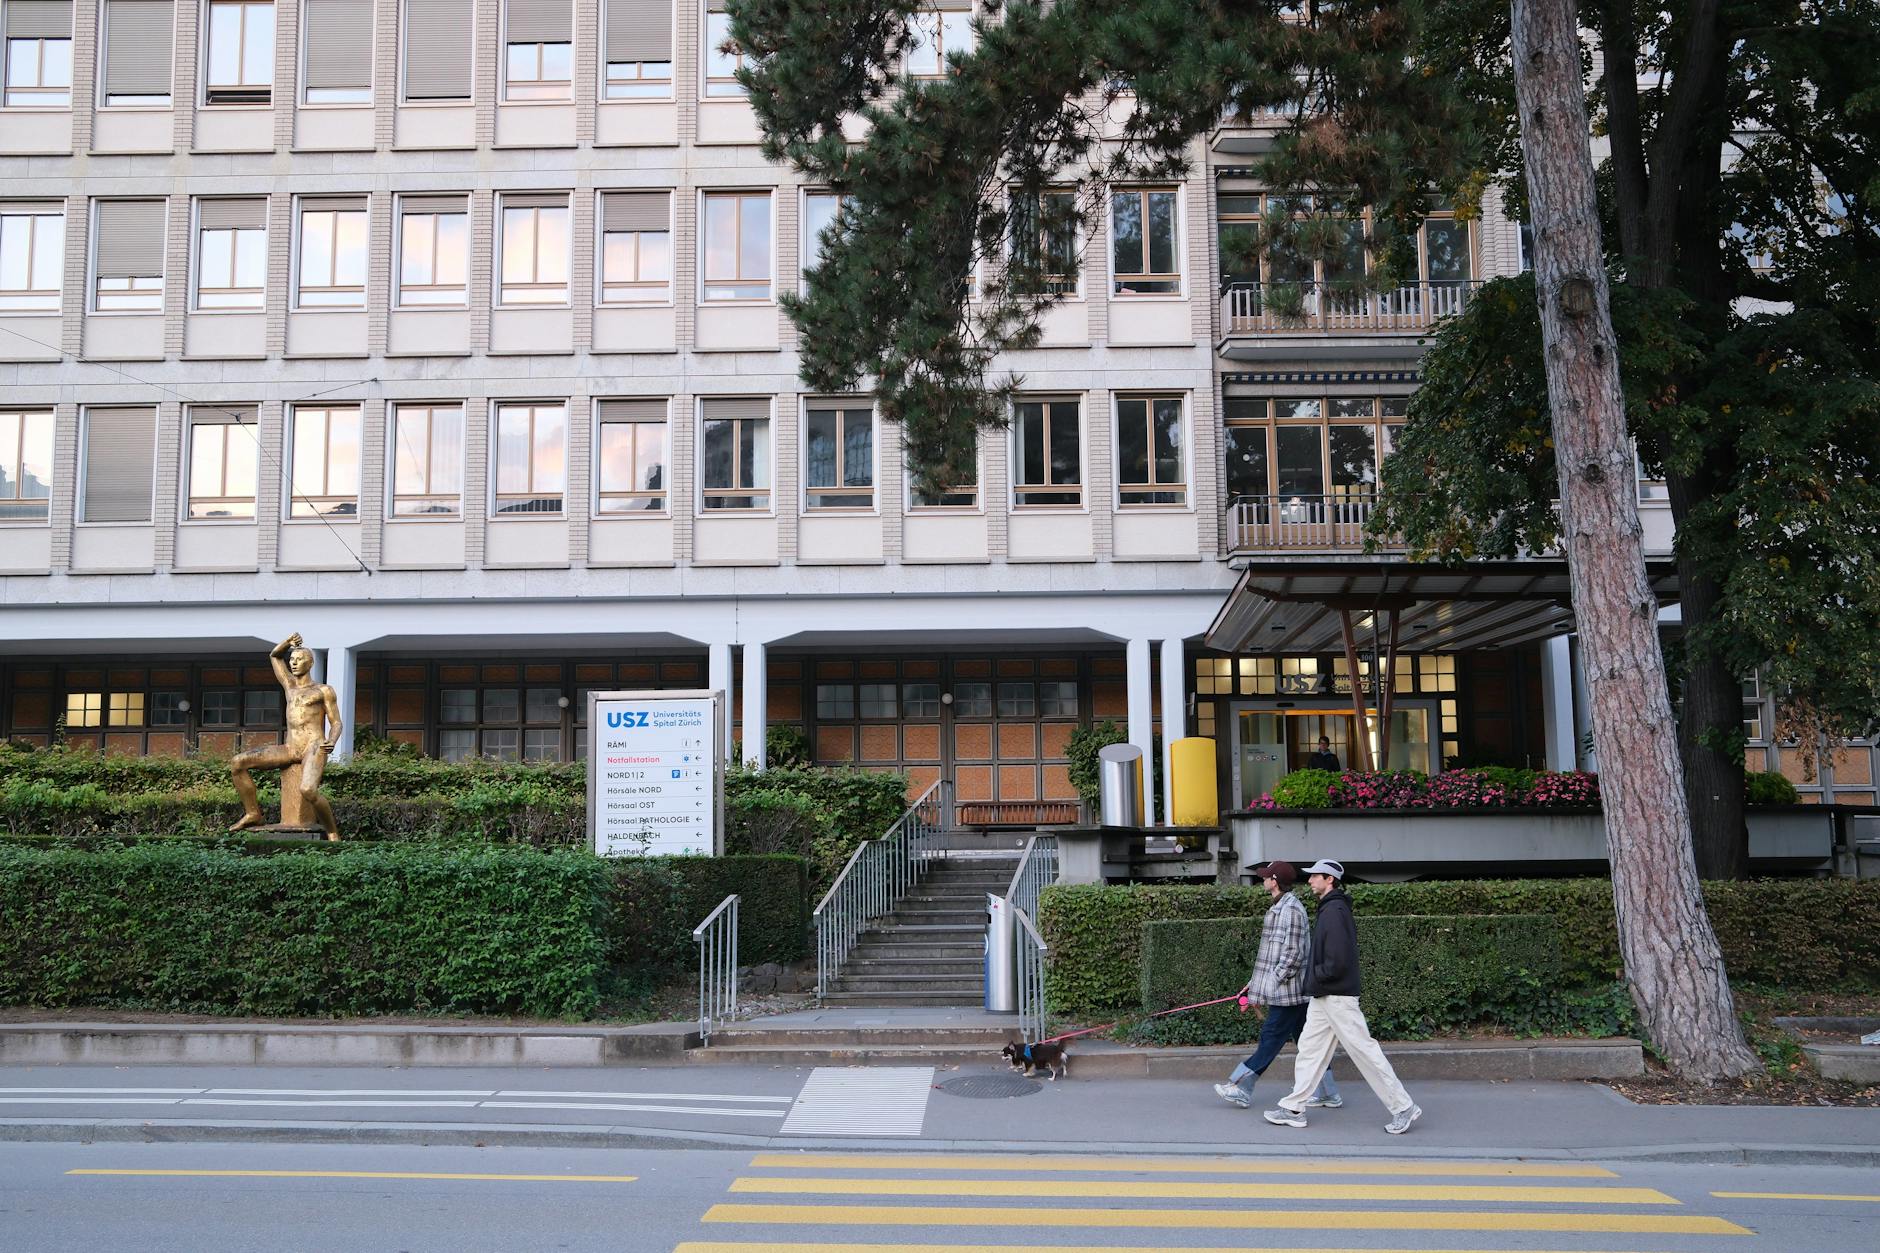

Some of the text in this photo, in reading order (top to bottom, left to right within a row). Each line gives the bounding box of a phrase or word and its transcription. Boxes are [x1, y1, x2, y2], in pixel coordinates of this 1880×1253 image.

[1275, 673, 1327, 693] USZ
[653, 710, 702, 718] Universitäts
[607, 712, 649, 728] USZ
[653, 719, 702, 728] Spital Zürich
[607, 741, 627, 749] RÄMI
[607, 756, 660, 764] Notfallstation
[639, 786, 662, 794] NORD
[639, 801, 656, 809] OST
[607, 816, 690, 825] Hörsaal PATHOLOGIE
